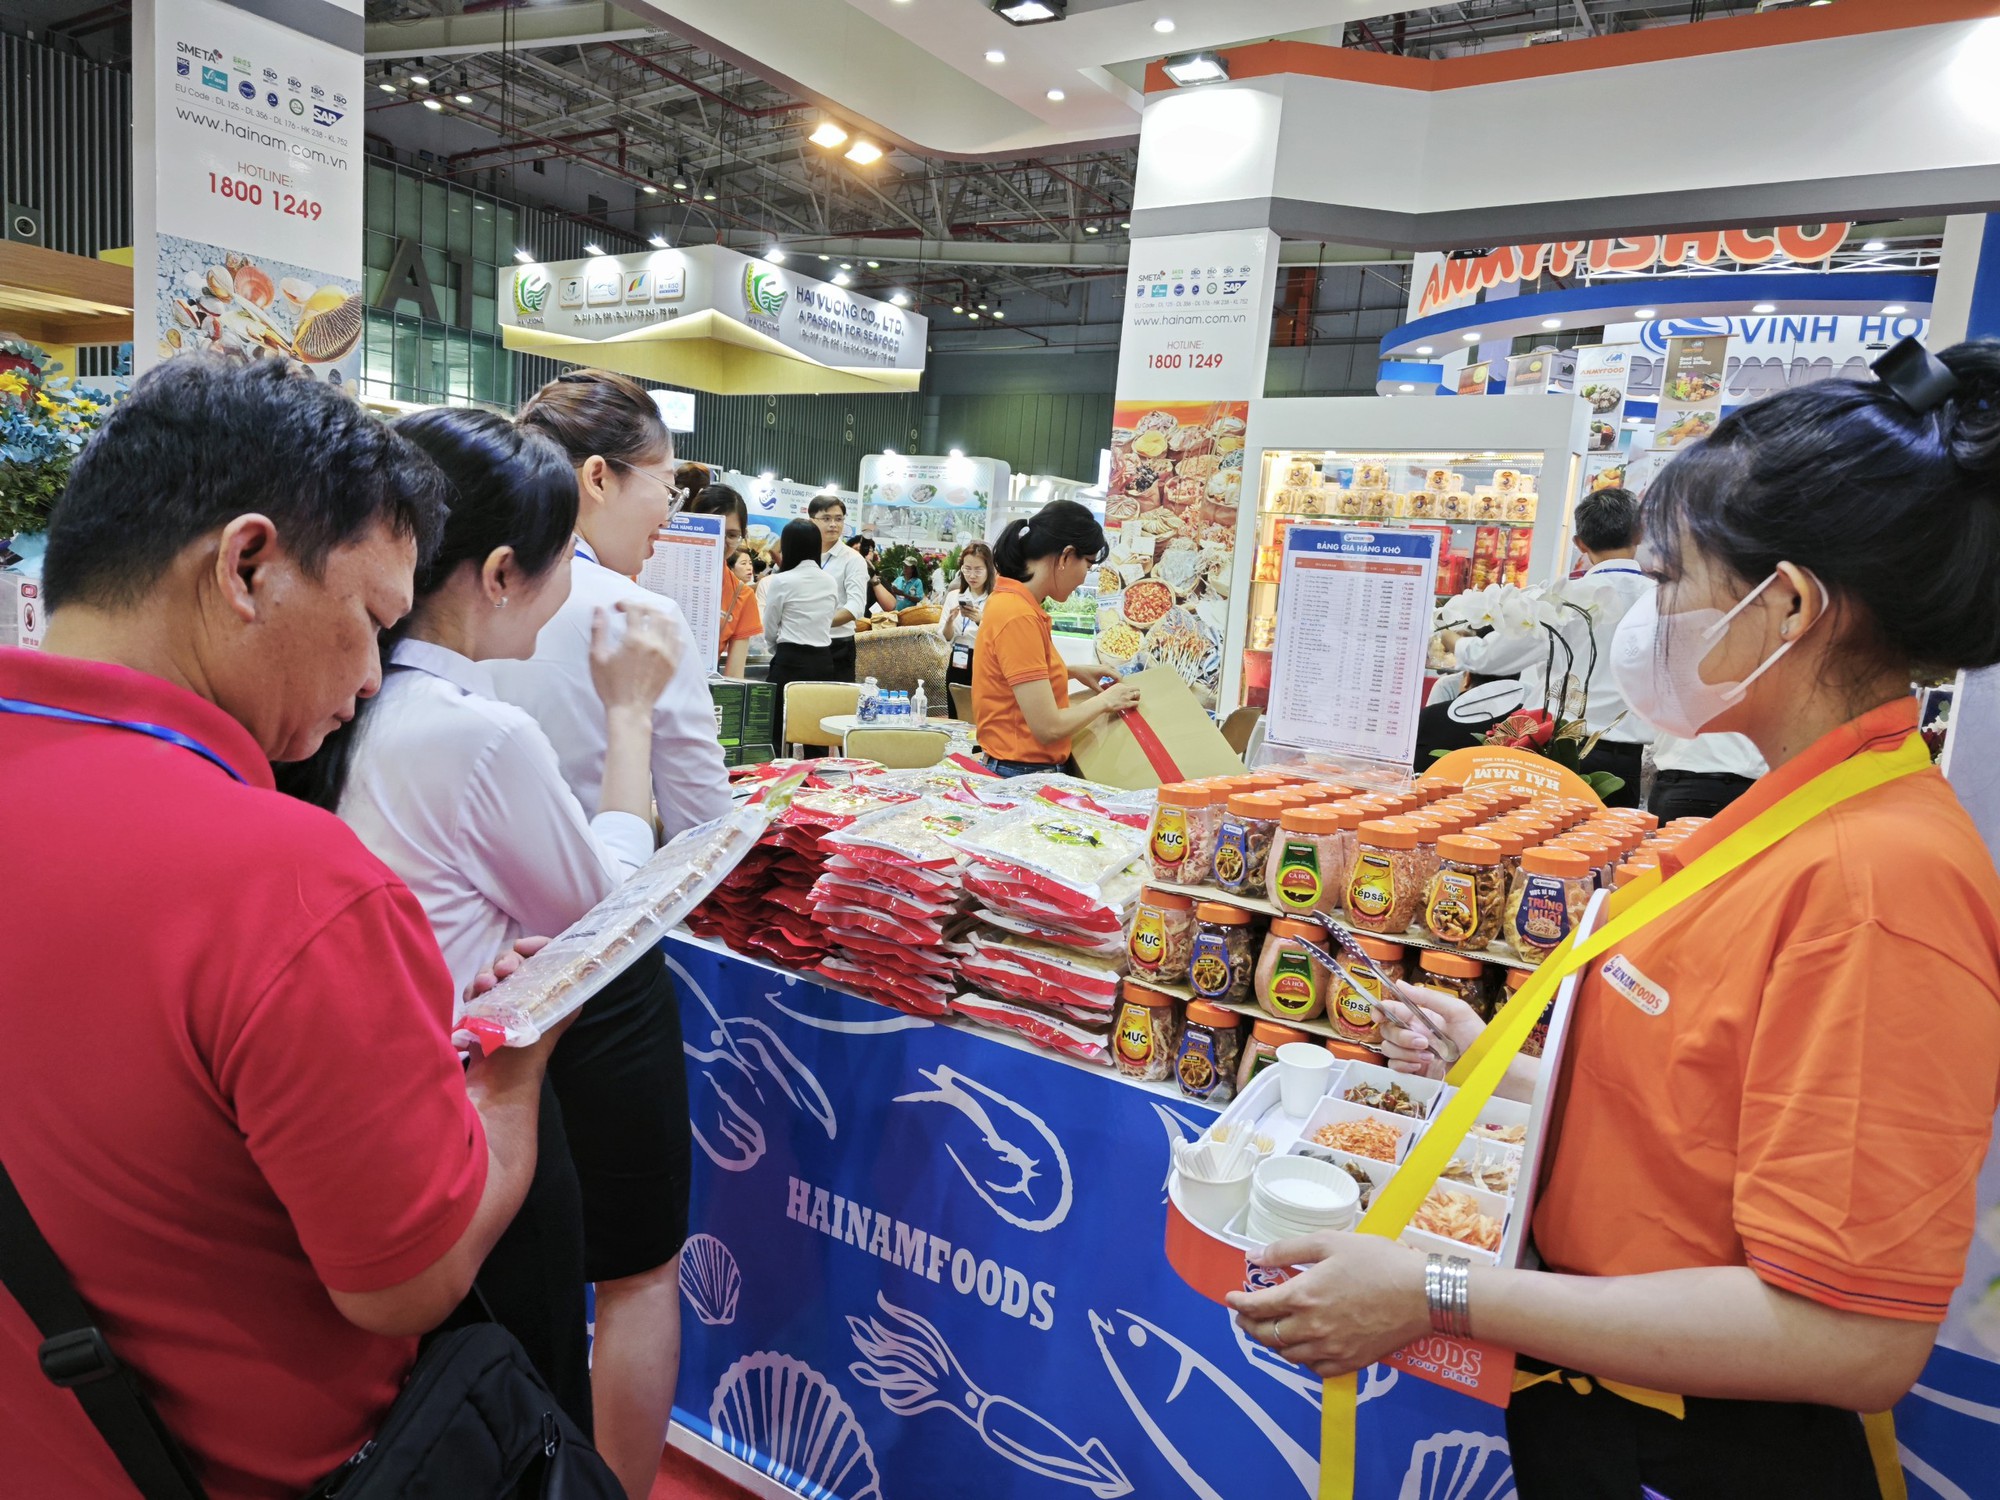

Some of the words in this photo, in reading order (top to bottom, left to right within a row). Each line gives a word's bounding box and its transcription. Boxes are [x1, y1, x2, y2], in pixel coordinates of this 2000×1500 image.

[176, 41, 216, 64] SMETA
[263, 69, 278, 79] ISO
[287, 78, 302, 88] ISO
[310, 86, 325, 96] ISO
[175, 83, 188, 94] EU
[188, 87, 210, 101] Code
[333, 95, 347, 105] ISO
[313, 107, 337, 124] SAP
[176, 106, 348, 171] www.hainam.com.vn
[237, 161, 293, 189] HOTLINE:
[208, 172, 262, 206] 1800
[272, 190, 322, 221] 1249
[1138, 273, 1161, 282] SMETA
[1224, 282, 1241, 292] SAP
[816, 293, 858, 319] VUONG
[1133, 314, 1246, 326] www.hainam.com.vn
[807, 312, 843, 333] PASSION
[845, 323, 861, 337] FOR
[863, 331, 900, 352] SEAFOOD
[1740, 317, 1838, 344] VINH
[1859, 316, 1932, 343] HO
[1167, 340, 1204, 350] HOTLINE:
[1148, 354, 1182, 369] 1800
[1188, 353, 1223, 368] 1249
[1317, 542, 1339, 551] BẢNG
[1341, 542, 1355, 552] GIÁ
[1356, 544, 1381, 554] HÀNG
[1383, 545, 1401, 555] KHÔ
[1474, 768, 1520, 780] NAM
[1156, 831, 1183, 845] MỰC
[1135, 931, 1161, 947] MỰC
[1122, 1029, 1148, 1044] MỰC
[786, 1175, 1056, 1331] HAINAMFOODS
[1407, 1355, 1438, 1373] your
[1442, 1368, 1478, 1388] plate
